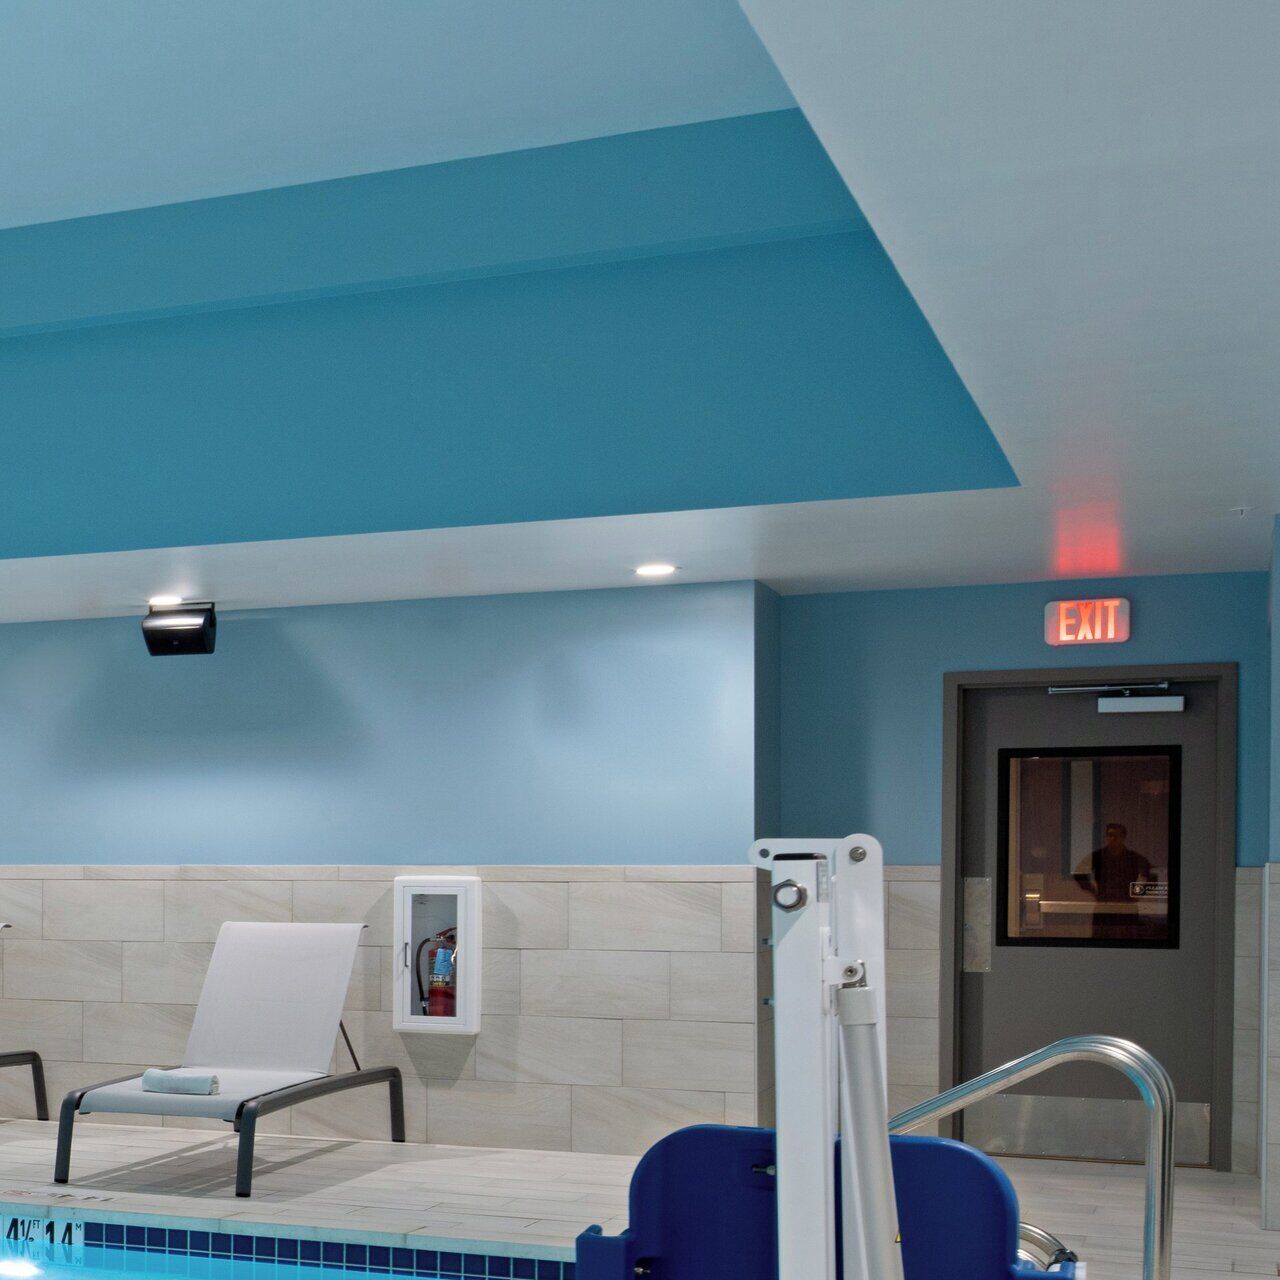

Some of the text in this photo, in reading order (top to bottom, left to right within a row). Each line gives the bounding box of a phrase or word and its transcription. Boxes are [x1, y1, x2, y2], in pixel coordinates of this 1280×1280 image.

[1059, 601, 1120, 641] EXIT
[33, 1219, 41, 1229] FT
[75, 1223, 82, 1231] M
